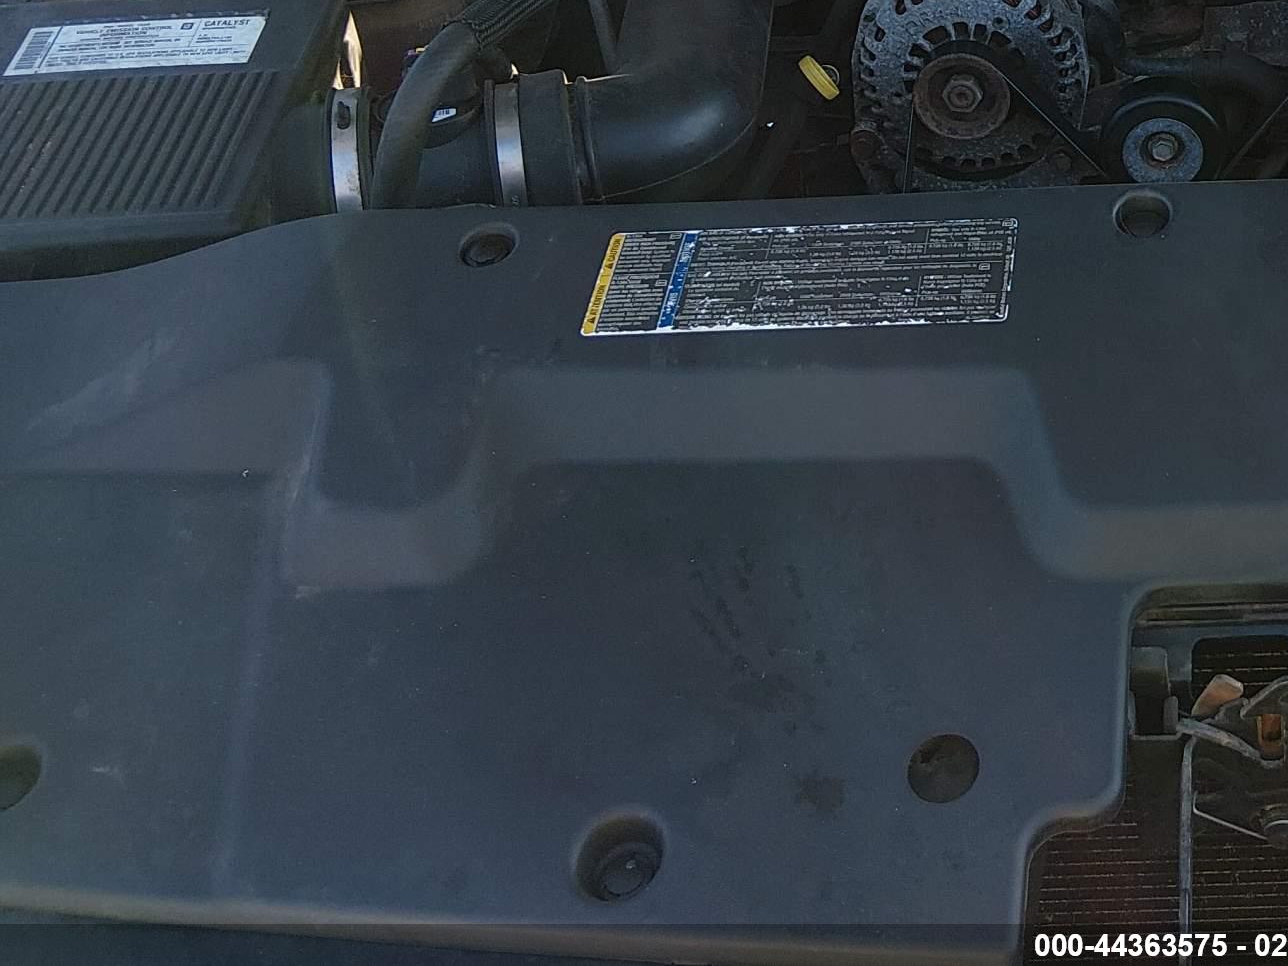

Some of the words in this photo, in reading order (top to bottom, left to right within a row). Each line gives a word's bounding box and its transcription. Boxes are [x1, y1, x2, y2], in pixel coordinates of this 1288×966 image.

[203, 19, 251, 27] CATALYST
[605, 238, 622, 263] CAUTION
[589, 284, 607, 316] ATTENTION
